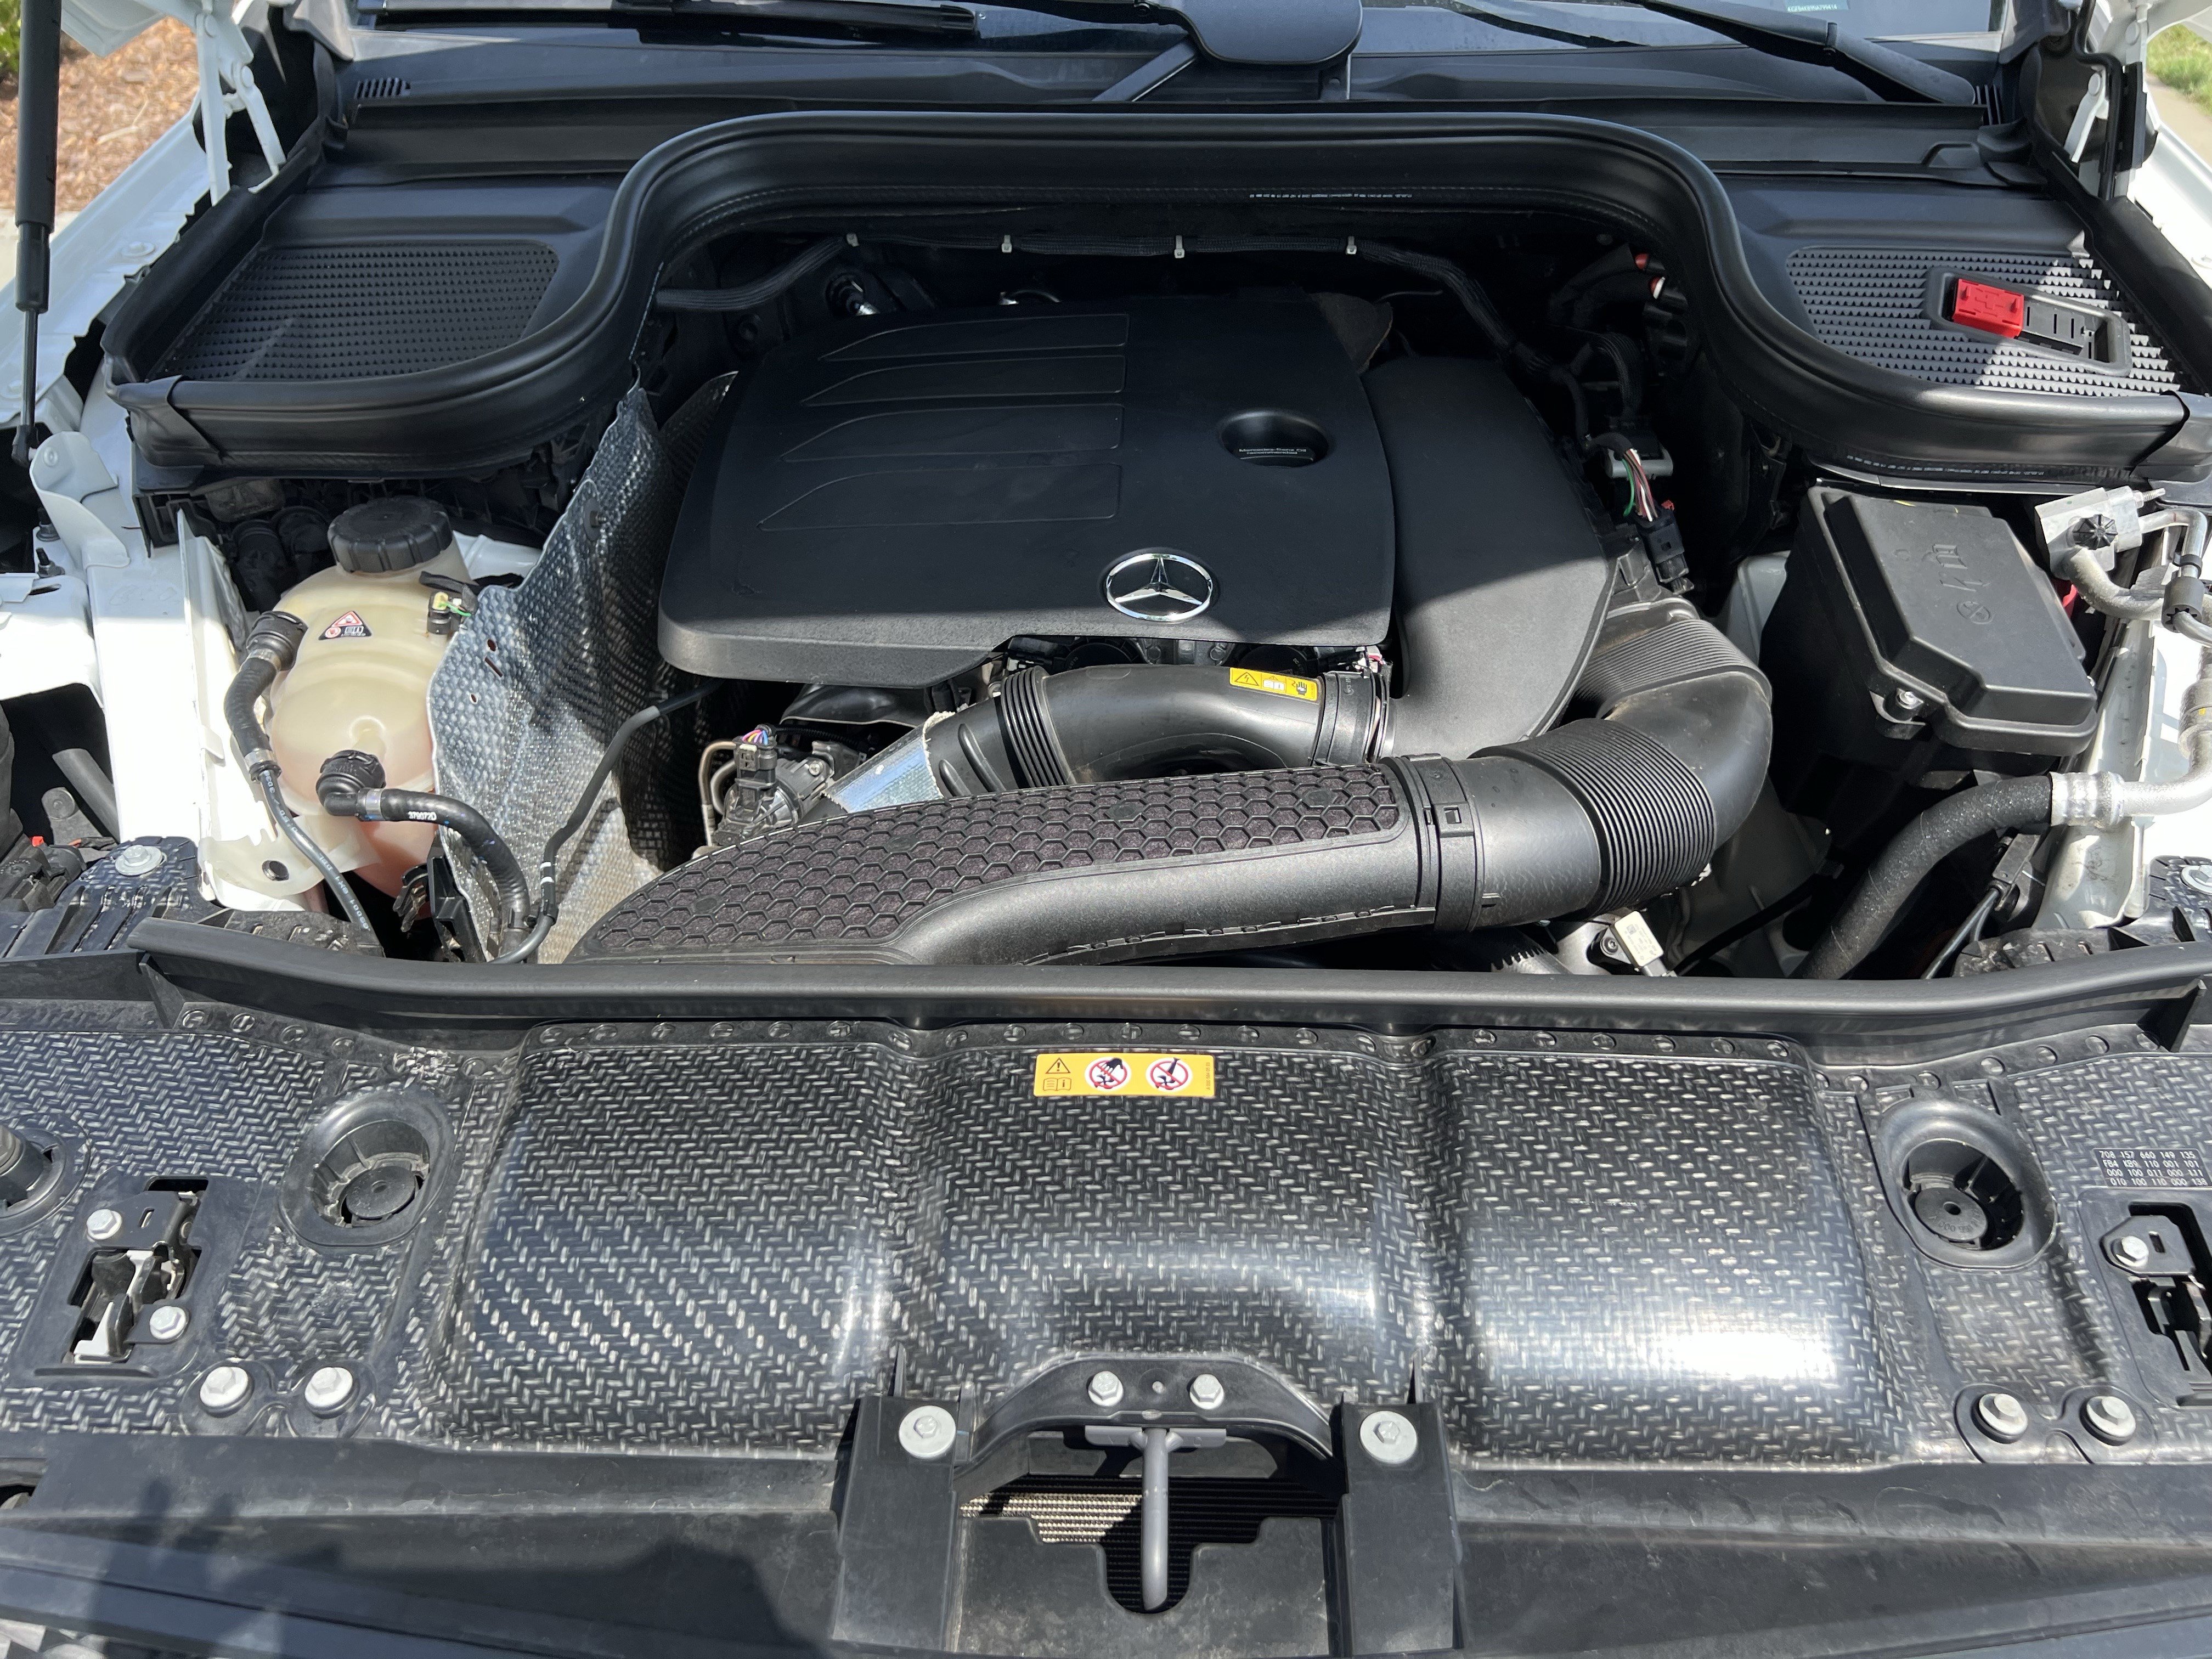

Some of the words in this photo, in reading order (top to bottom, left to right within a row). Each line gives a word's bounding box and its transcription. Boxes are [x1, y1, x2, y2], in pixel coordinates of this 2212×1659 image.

[2103, 1160, 2119, 1168] FB4
[2144, 1160, 2160, 1168] 110
[2163, 1160, 2179, 1168] 001
[2183, 1160, 2200, 1168] 101
